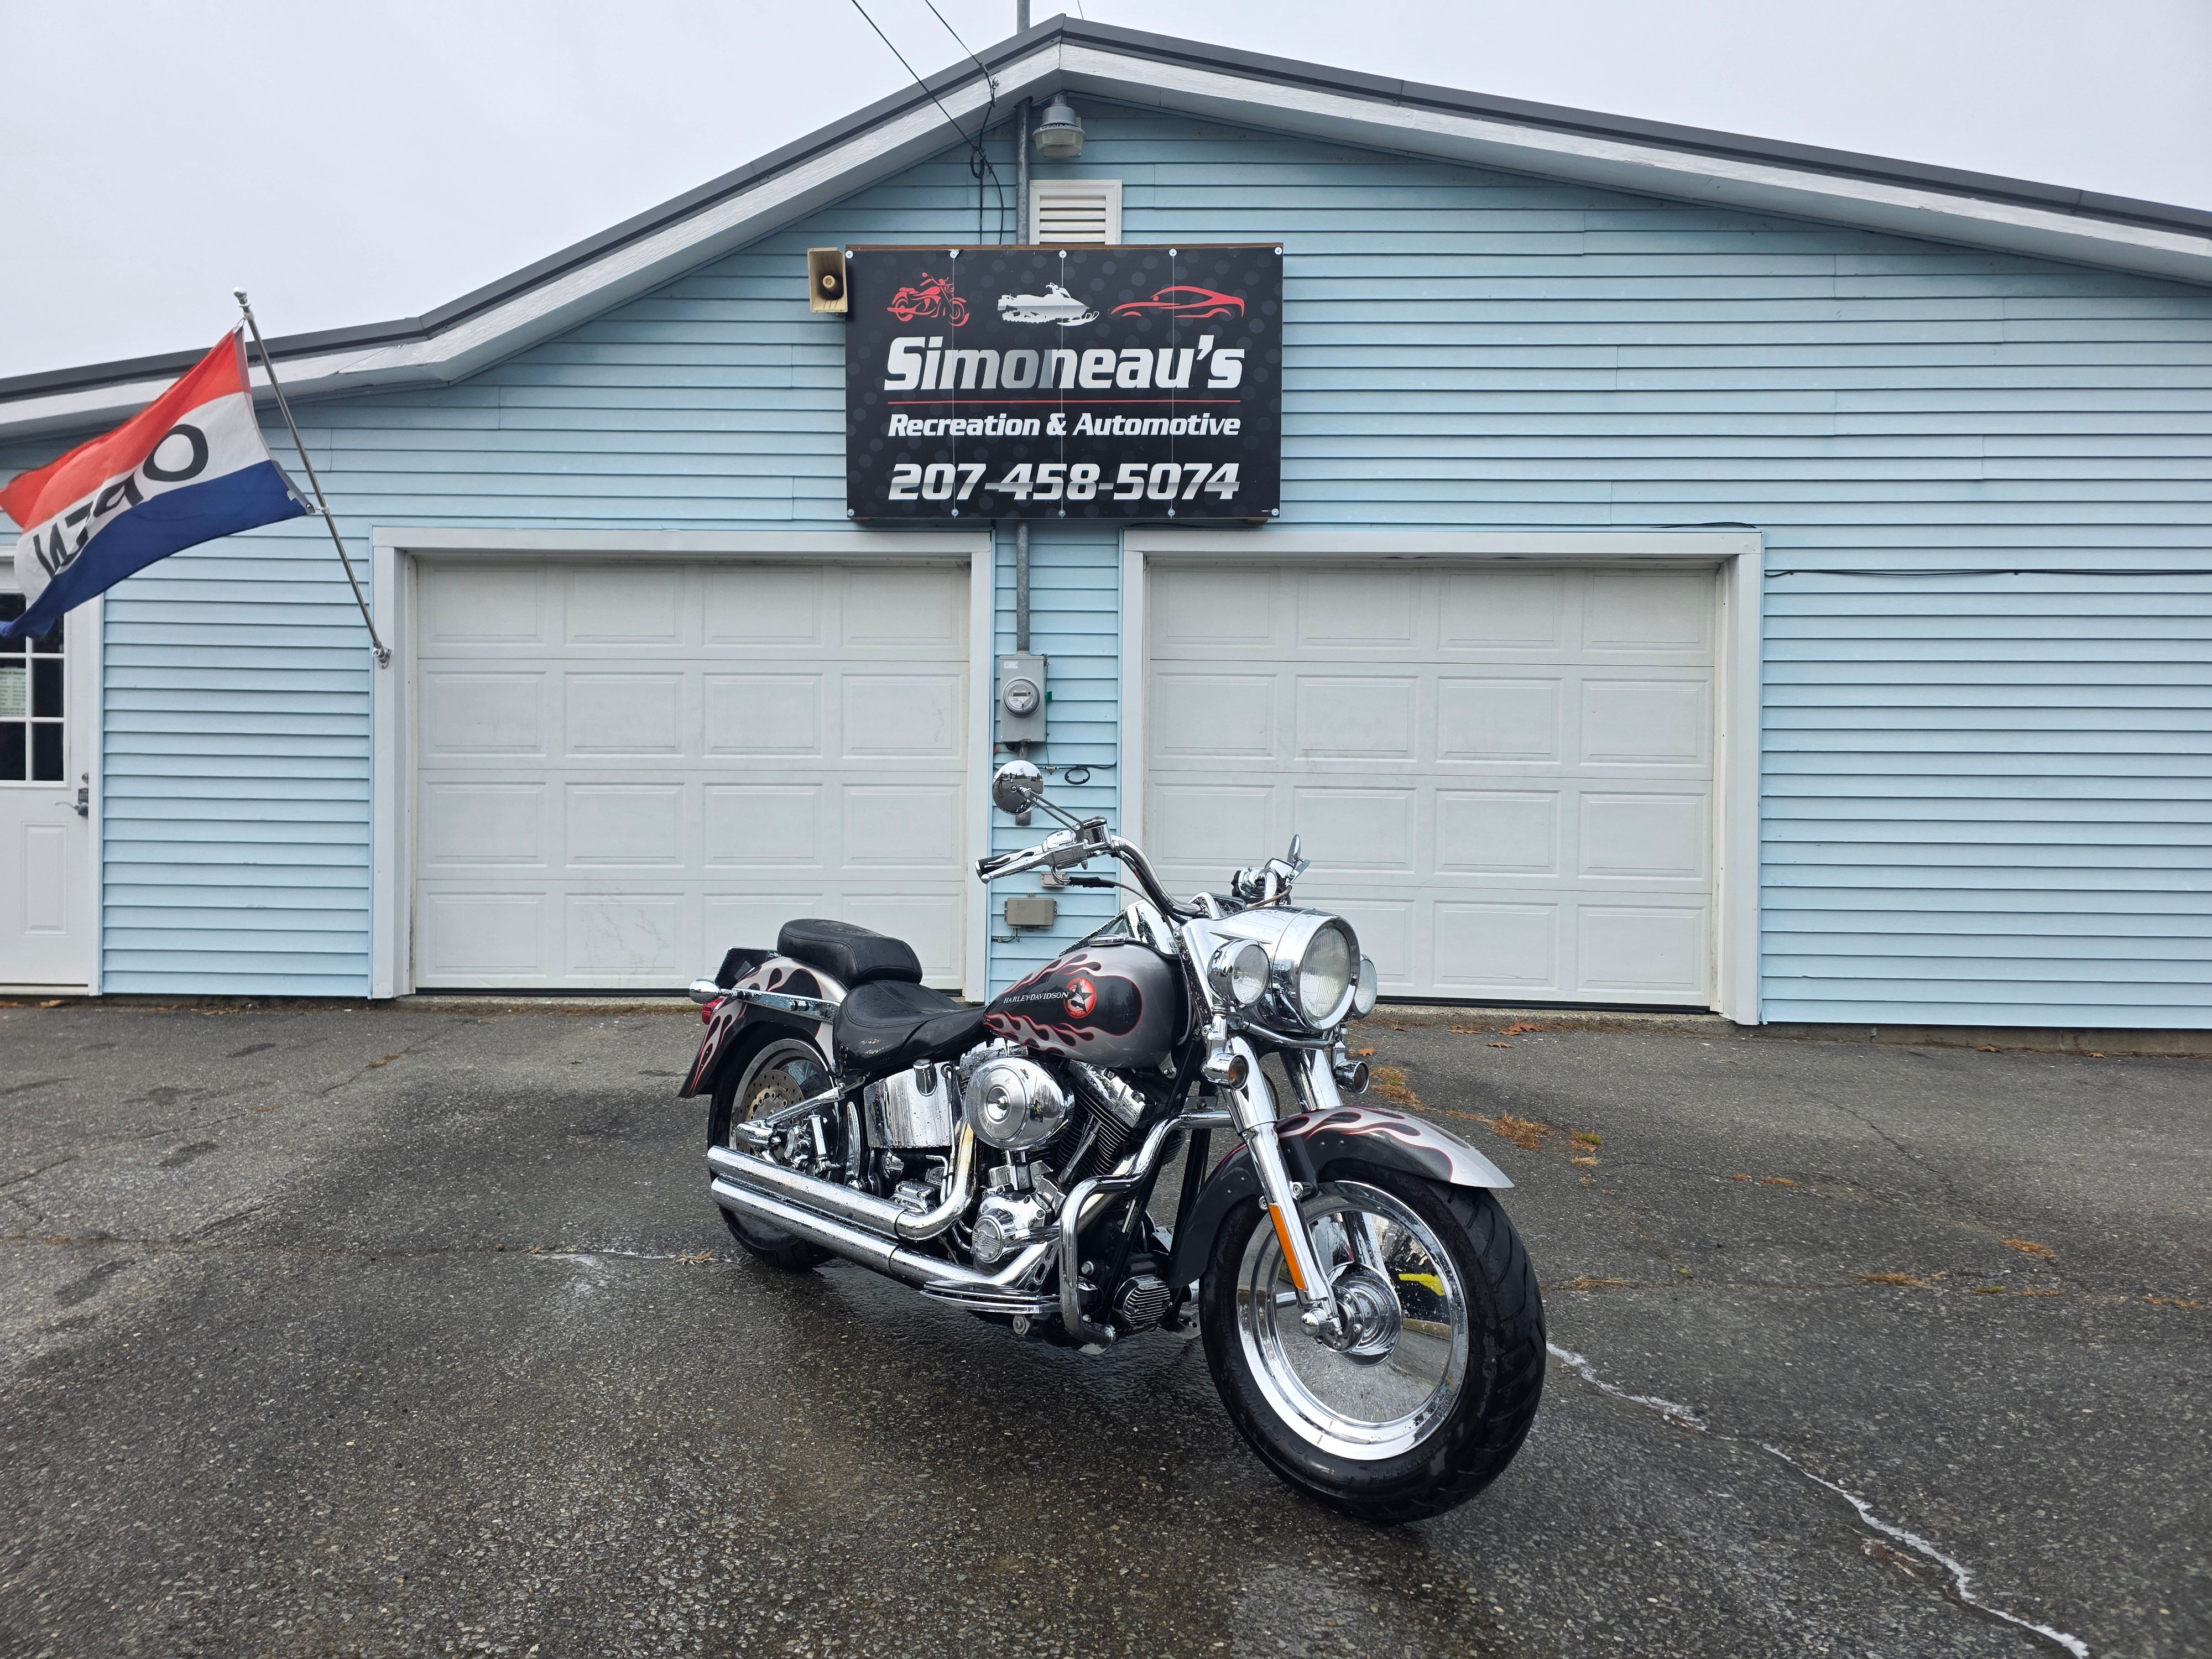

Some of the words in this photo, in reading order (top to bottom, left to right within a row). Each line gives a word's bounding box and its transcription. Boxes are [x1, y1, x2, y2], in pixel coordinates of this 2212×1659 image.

[884, 335, 1245, 390] Simoneau's
[888, 414, 1040, 437] Recreation
[1046, 413, 1067, 436] &
[1072, 412, 1241, 436] Automotive
[888, 463, 1240, 500] 207-458-5074
